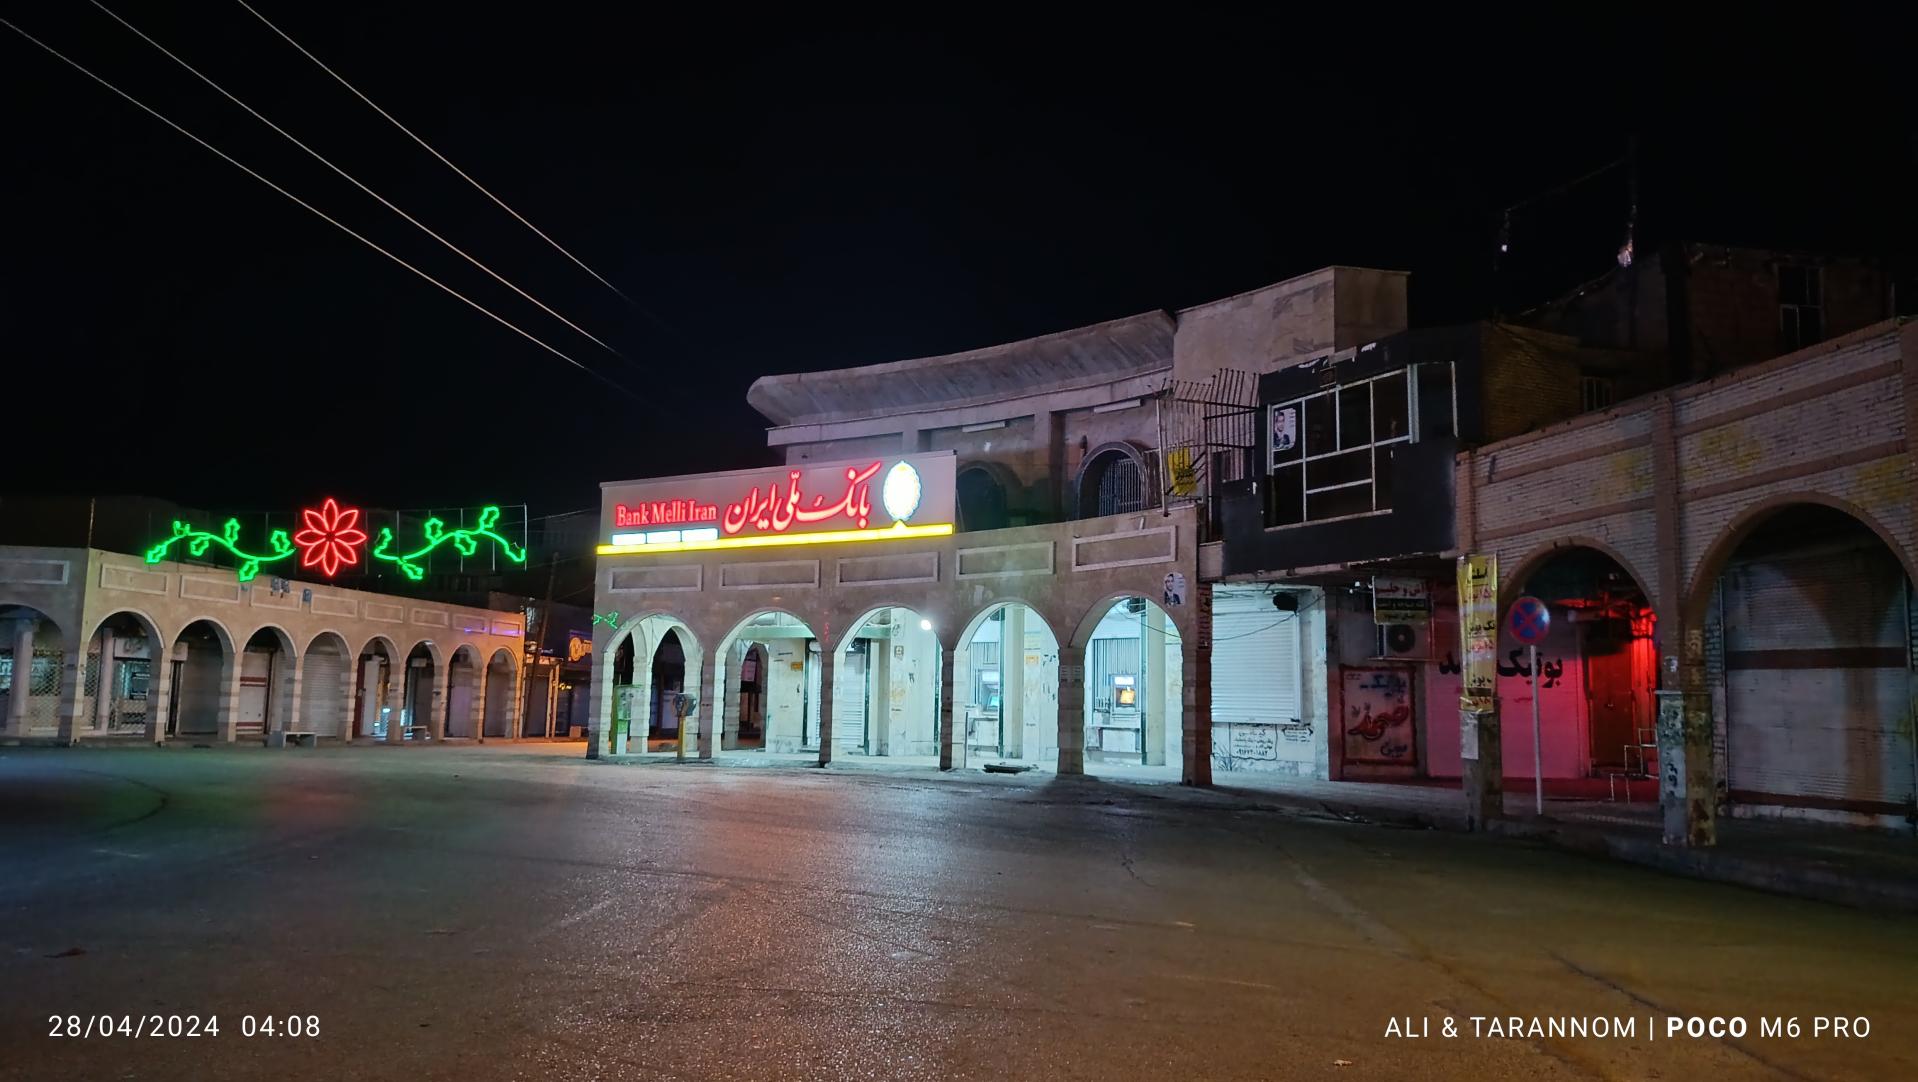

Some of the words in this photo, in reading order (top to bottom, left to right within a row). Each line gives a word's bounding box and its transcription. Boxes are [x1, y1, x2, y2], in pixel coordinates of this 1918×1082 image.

[616, 503, 649, 527] Bank
[651, 499, 686, 524] Melli
[687, 499, 717, 521] Iran
[723, 483, 777, 534] ایران
[795, 461, 882, 529] بانک
[1498, 648, 1563, 689] بوتیک
